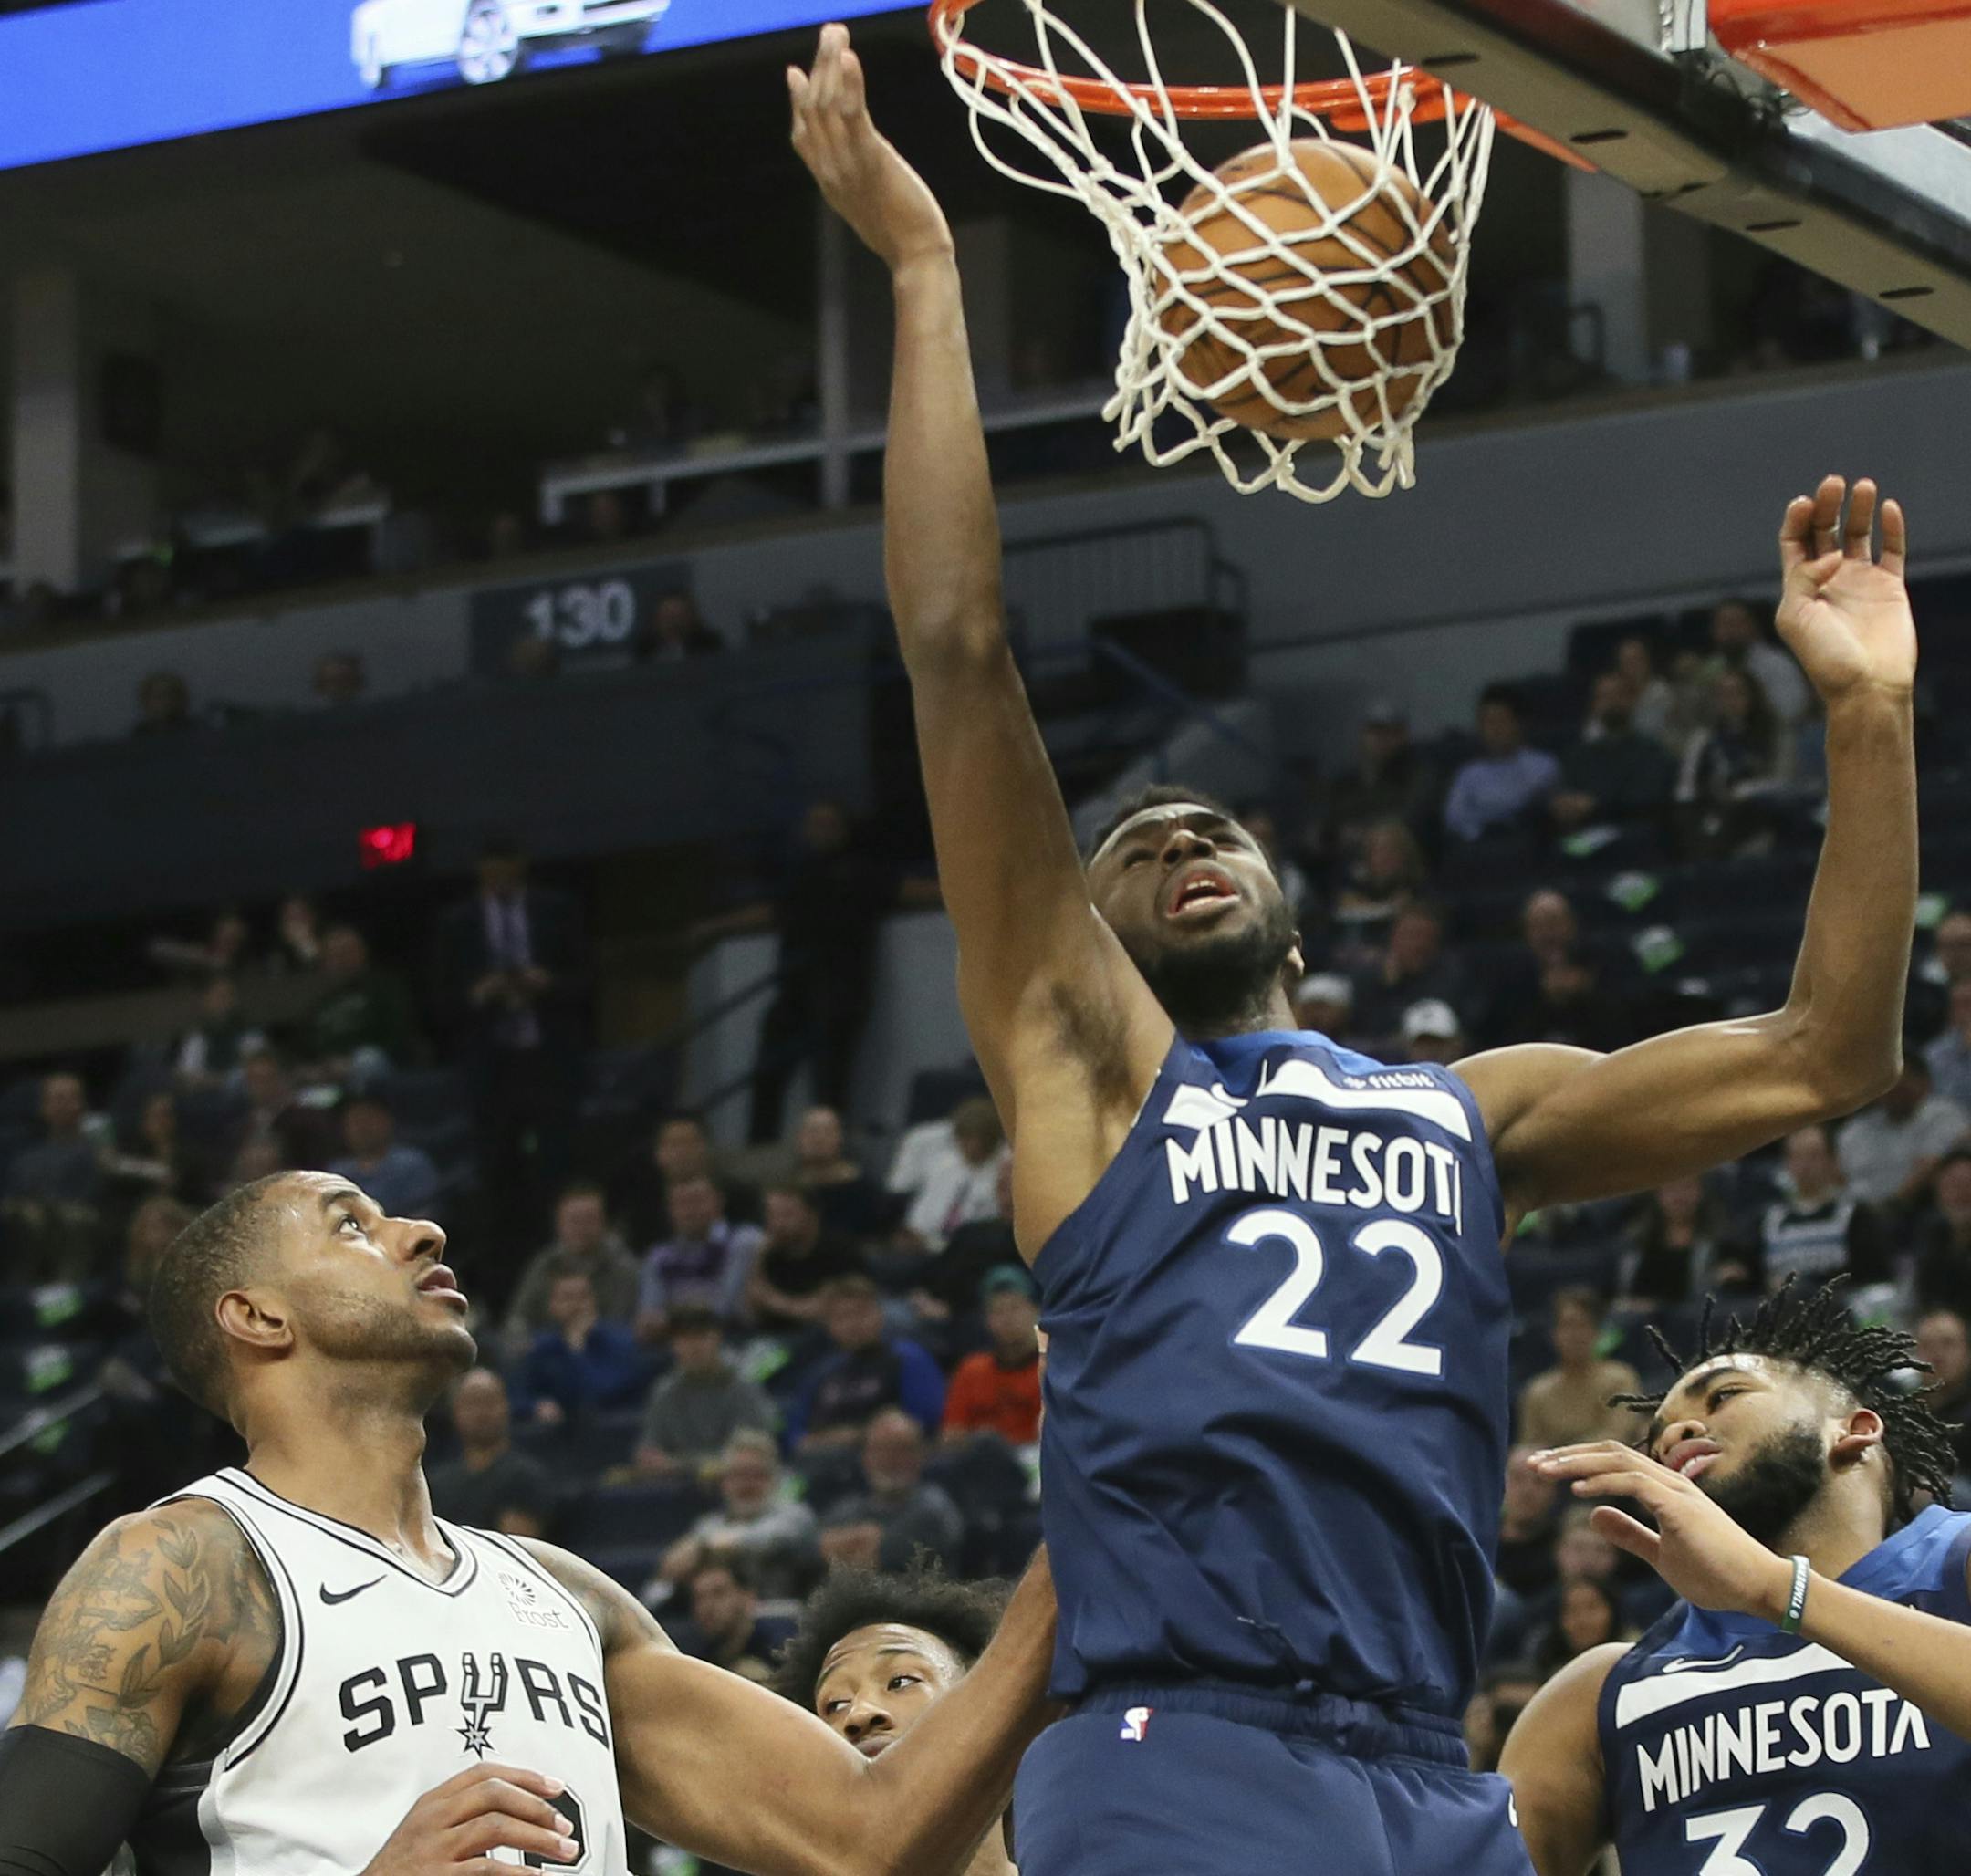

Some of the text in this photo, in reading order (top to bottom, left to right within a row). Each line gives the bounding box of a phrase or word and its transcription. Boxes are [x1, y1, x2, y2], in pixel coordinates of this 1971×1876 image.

[522, 578, 637, 647] 130
[1369, 1072, 1434, 1088] fitbit
[1165, 1115, 1463, 1236] MINNESOT
[1226, 1208, 1443, 1376] 22
[339, 1652, 610, 1756] SPURS
[1636, 1688, 1931, 1812] MINNESOTA
[1685, 1792, 1870, 1876] 32
